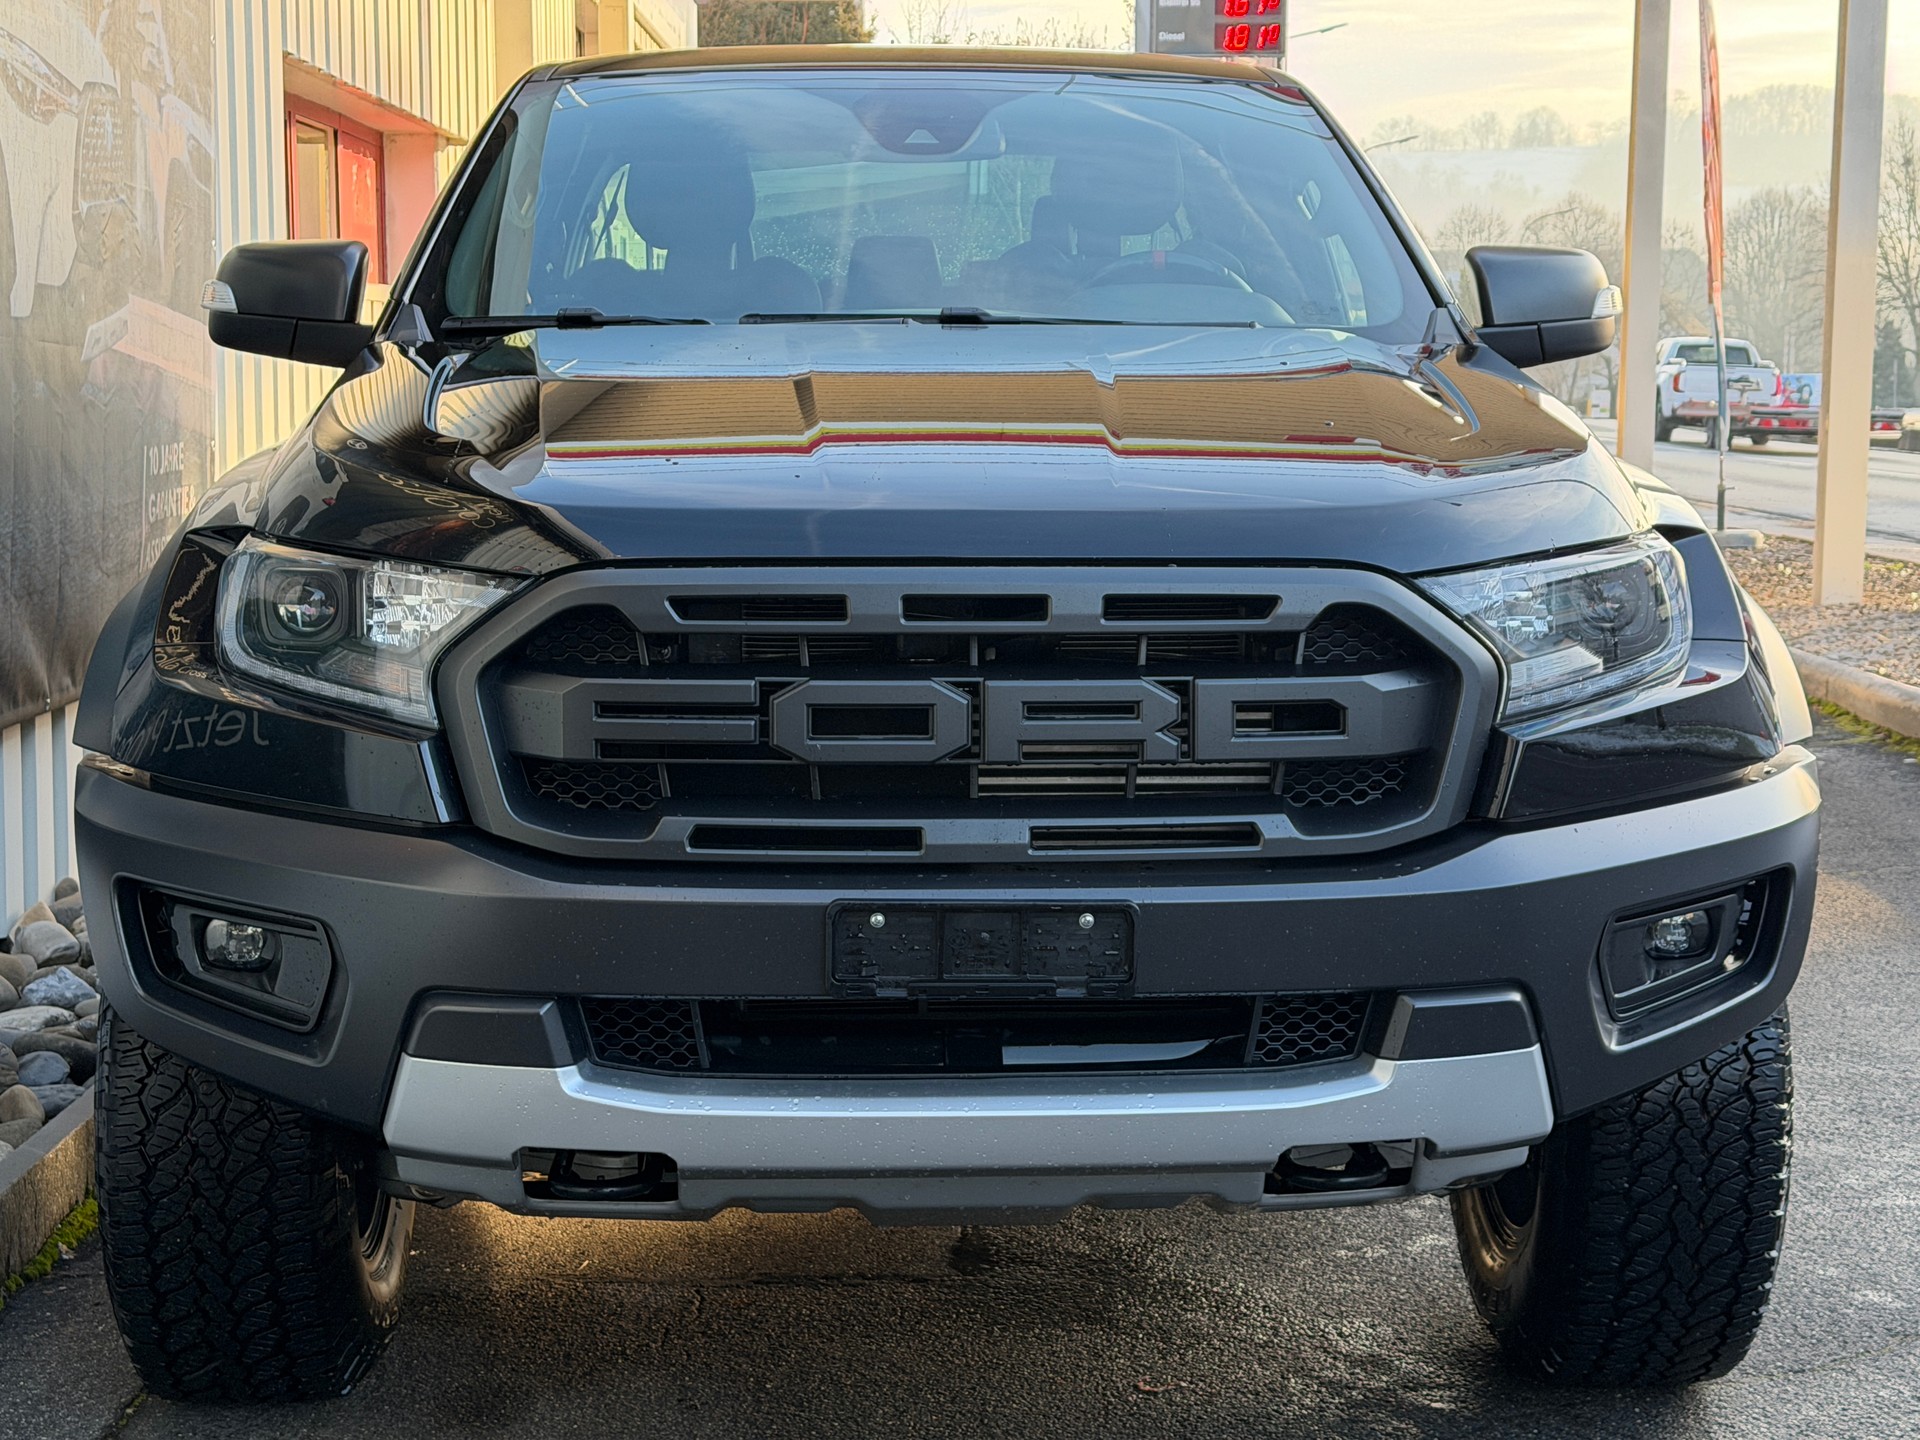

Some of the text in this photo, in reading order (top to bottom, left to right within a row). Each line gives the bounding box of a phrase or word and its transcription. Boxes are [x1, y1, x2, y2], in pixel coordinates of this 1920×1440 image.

[1158, 31, 1185, 42] Diesel
[149, 442, 184, 476] 10 JAHRE
[149, 485, 190, 523] GARANTIE
[562, 676, 1390, 764] FORD
